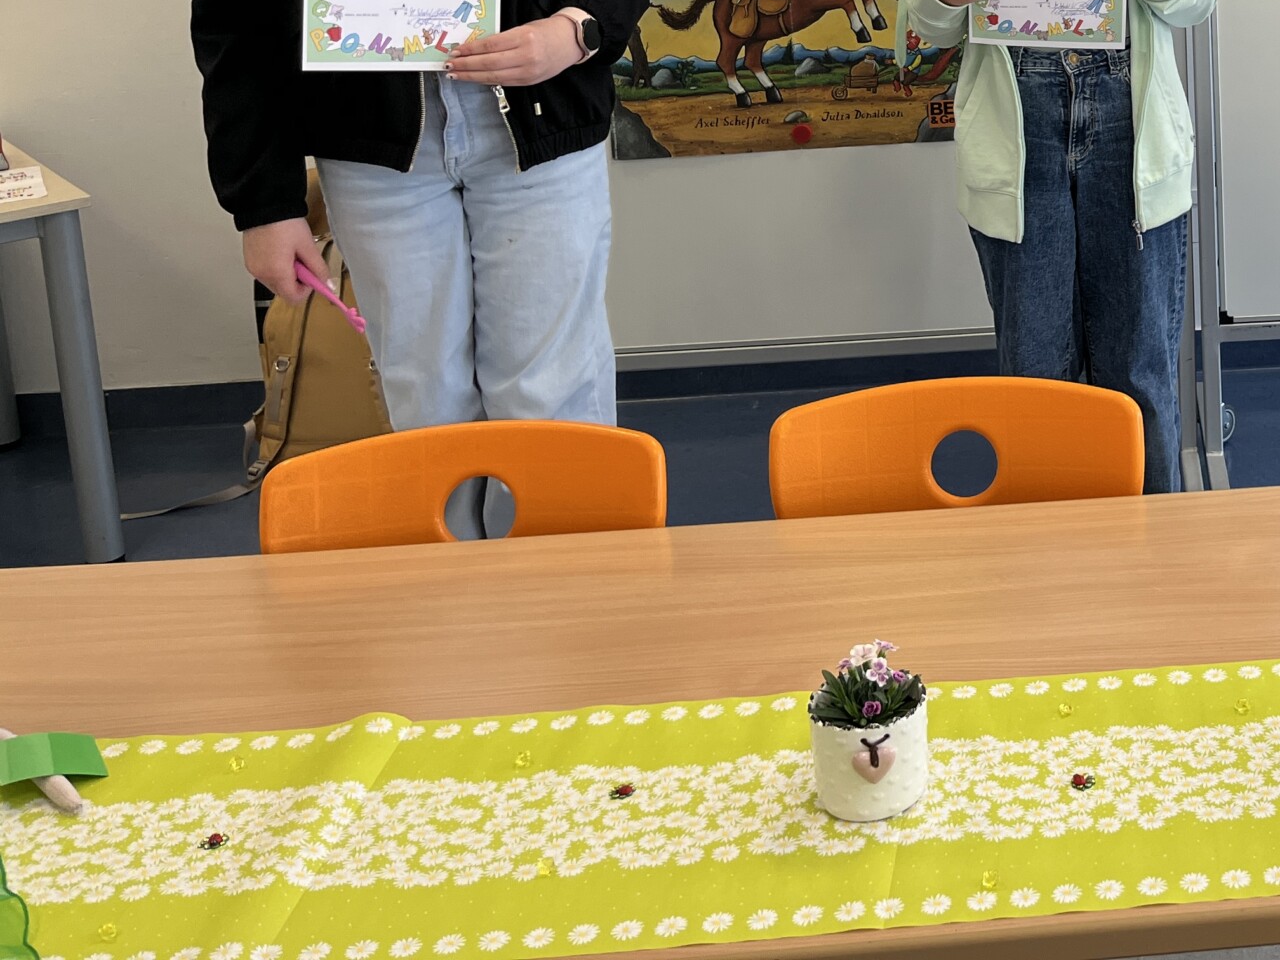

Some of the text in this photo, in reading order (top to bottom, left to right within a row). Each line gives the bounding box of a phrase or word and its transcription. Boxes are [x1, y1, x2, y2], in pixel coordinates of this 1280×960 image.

[822, 109, 904, 122] Julia Donaldson
[695, 116, 771, 129] Axel Scheffler
